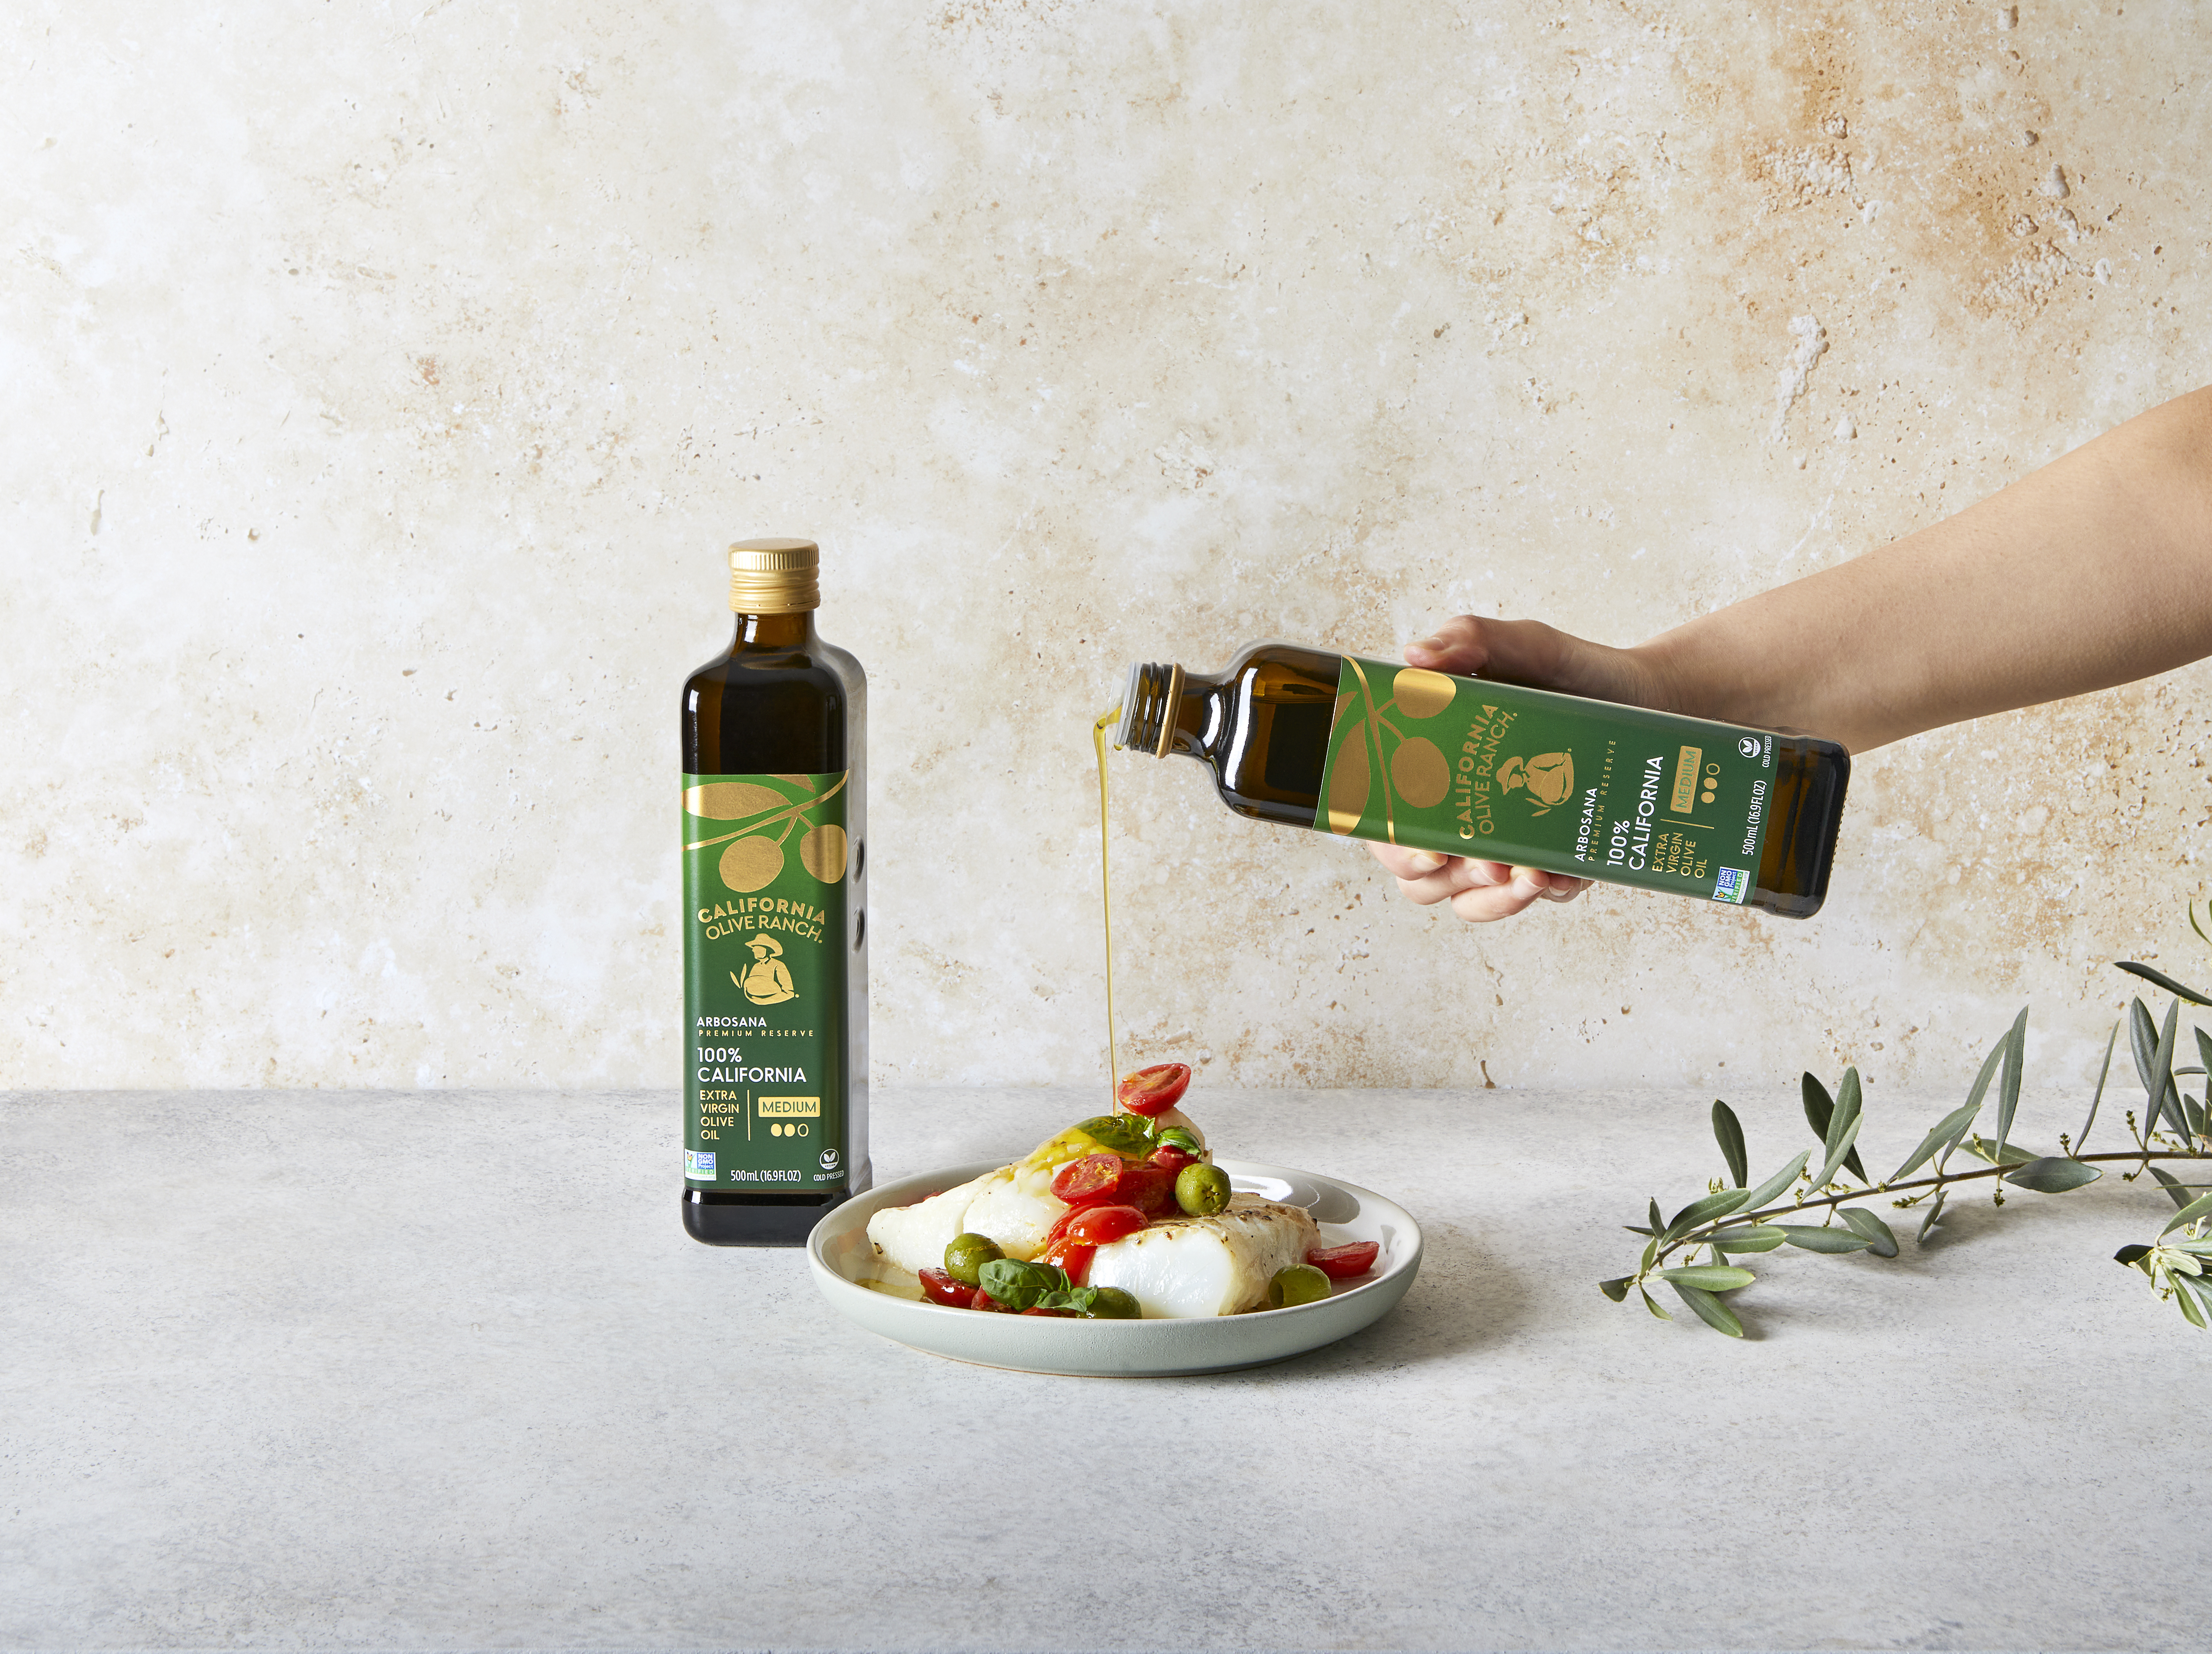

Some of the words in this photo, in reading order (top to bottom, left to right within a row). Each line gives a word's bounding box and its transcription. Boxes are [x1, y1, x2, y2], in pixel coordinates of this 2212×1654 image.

[1764, 735, 1772, 754] PRESSED
[1762, 754, 1770, 768] COLD
[1456, 705, 1499, 840] CALIFORNIA
[1675, 750, 1697, 808] MEDIUM
[1475, 781, 1494, 834] OLIVE
[1588, 805, 1605, 862] PREMIUM
[1600, 740, 1616, 796] RESERVE
[1628, 756, 1664, 870] CALIFORNIA
[1574, 788, 1598, 862] ARBOSANA
[1606, 820, 1630, 866] 100%
[1652, 833, 1669, 872] EXTRA
[1666, 832, 1683, 873] VIRGIN
[1680, 840, 1696, 876] OLIVE
[1694, 859, 1707, 878] OIL
[1719, 870, 1727, 886] NON
[1724, 870, 1732, 887] GMO
[1731, 873, 1743, 902] VERIFIED
[698, 897, 825, 925] CALIFORNIA
[706, 915, 755, 940] OLIVE
[696, 1017, 767, 1027] ARBOSANA
[697, 1047, 742, 1063] 100%
[697, 1067, 807, 1083] CALIFORNIA
[700, 1090, 737, 1101] EXTRA
[700, 1103, 739, 1114] VIRGIN
[763, 1101, 816, 1113] MEDIUM
[700, 1117, 734, 1127] OLIVE
[701, 1130, 720, 1141] OIL
[827, 1170, 844, 1180] PRESSED
